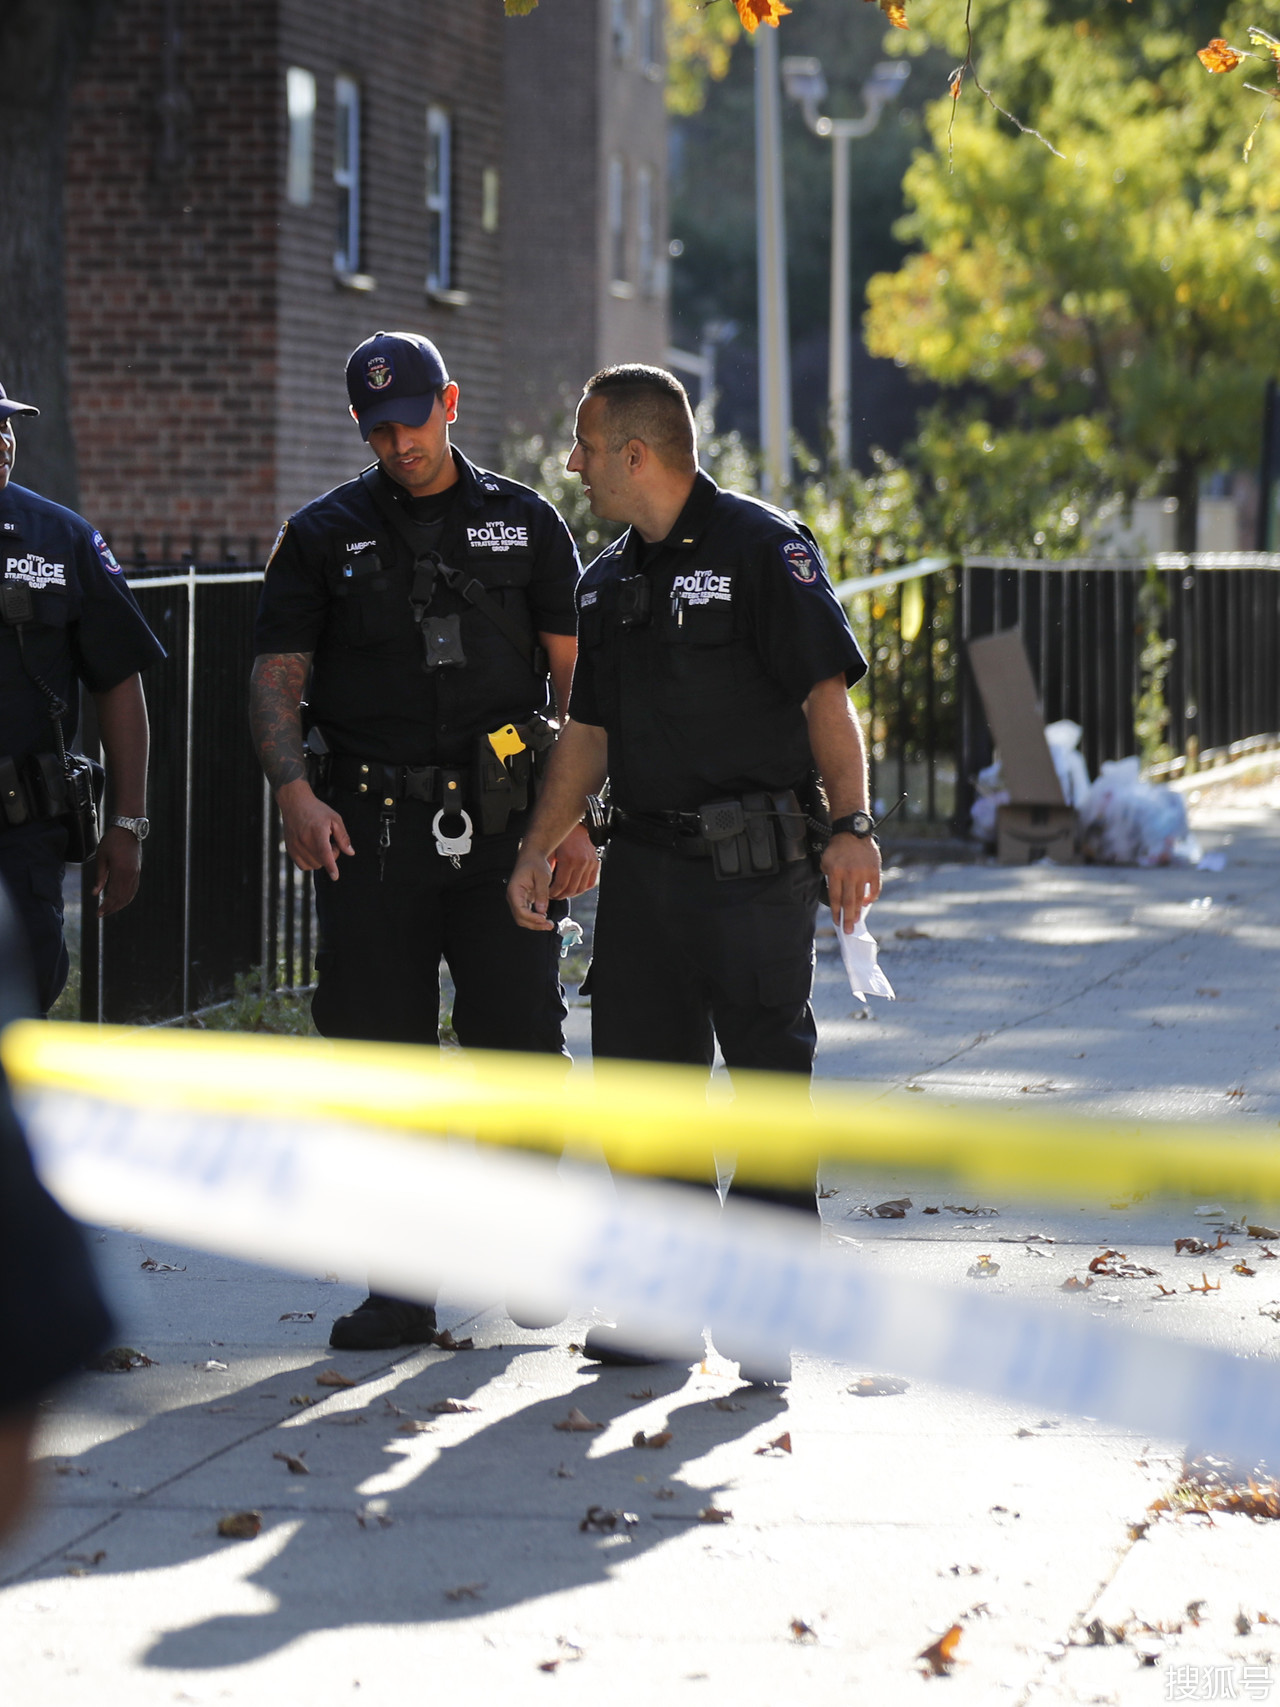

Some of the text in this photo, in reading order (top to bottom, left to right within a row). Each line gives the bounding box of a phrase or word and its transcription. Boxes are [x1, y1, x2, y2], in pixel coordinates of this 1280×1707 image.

[466, 527, 529, 541] POLICE
[26, 553, 45, 563] NYPD
[6, 557, 65, 579] POLICE
[28, 581, 47, 589] ROUP
[672, 575, 732, 593] POLICE
